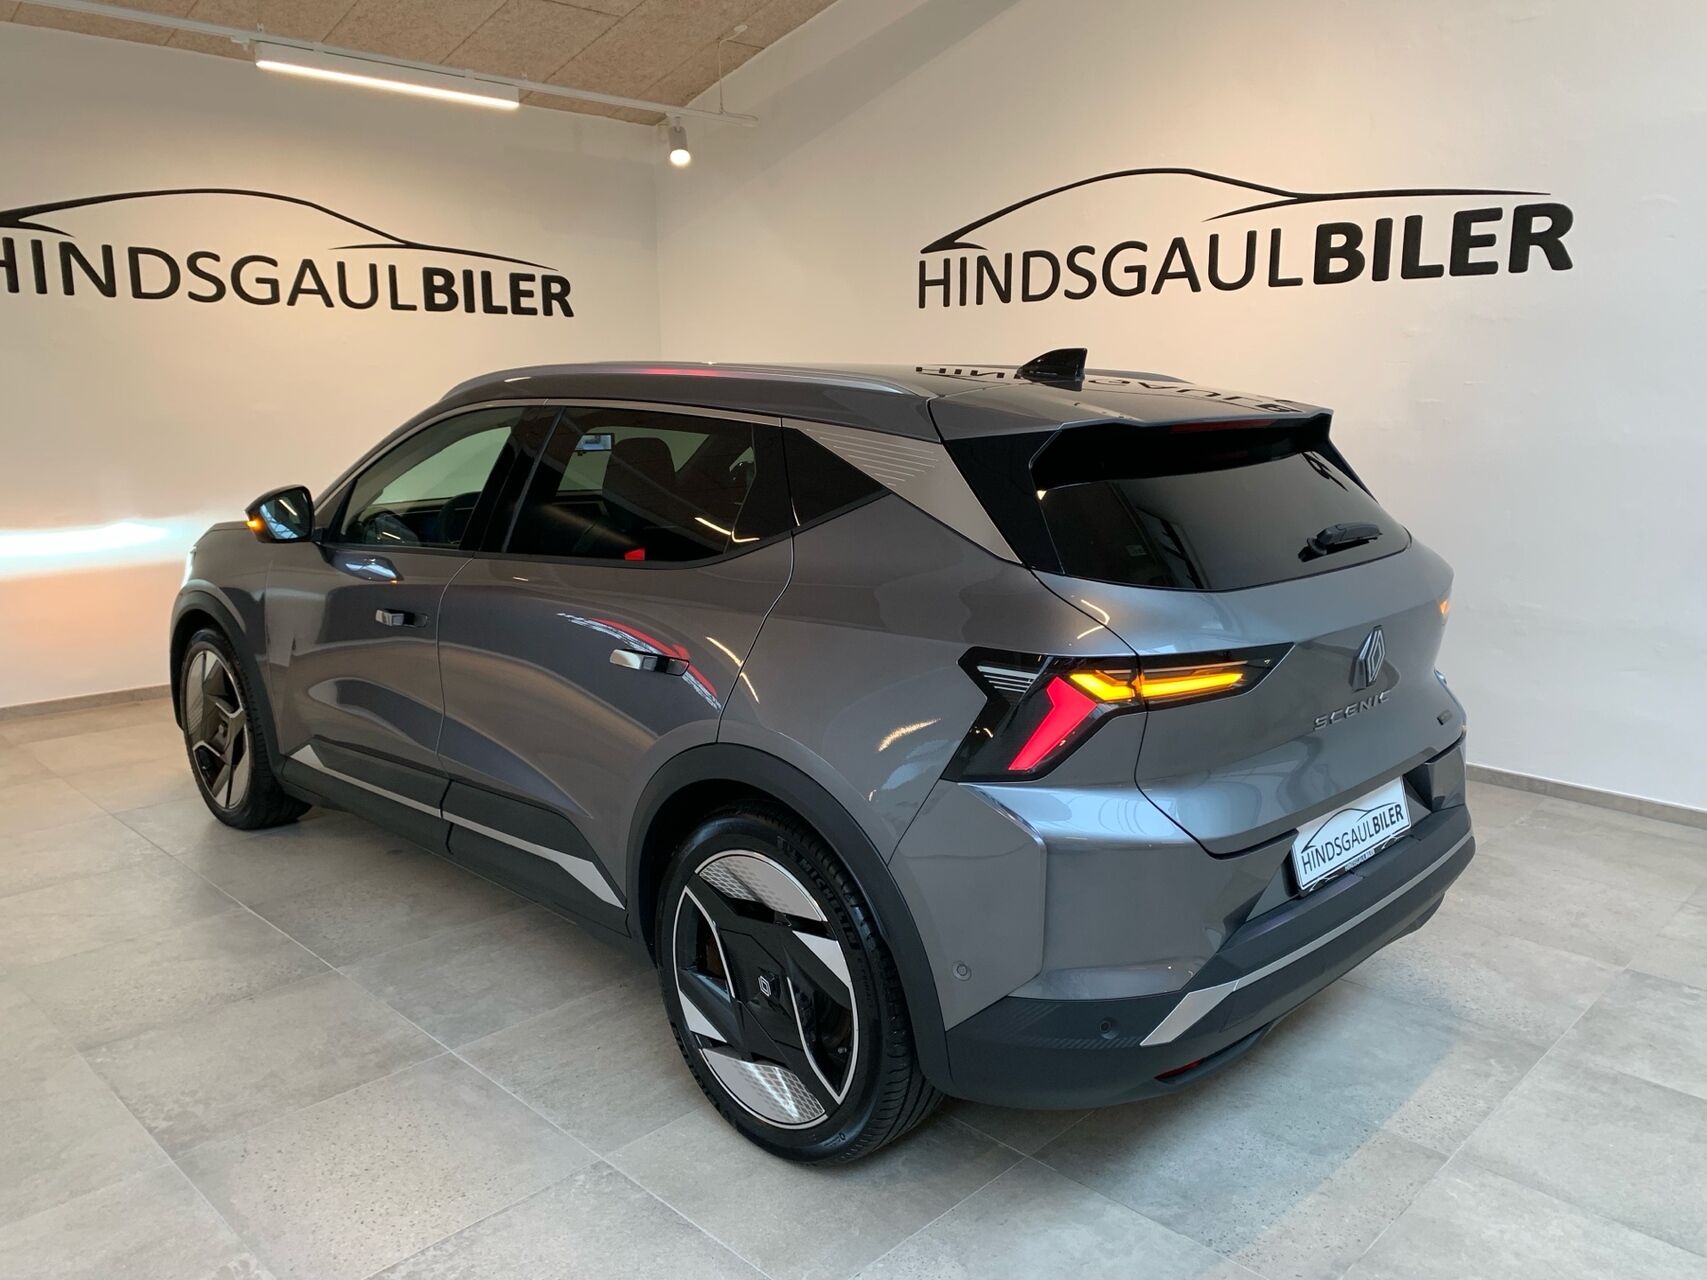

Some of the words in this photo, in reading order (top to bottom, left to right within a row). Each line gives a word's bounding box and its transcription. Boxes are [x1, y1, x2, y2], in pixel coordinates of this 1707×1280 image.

[918, 203, 1574, 309] HINDSGAULBILER
[1313, 690, 1391, 731] SCENIC
[1301, 804, 1404, 875] HINDSGAULBILER
